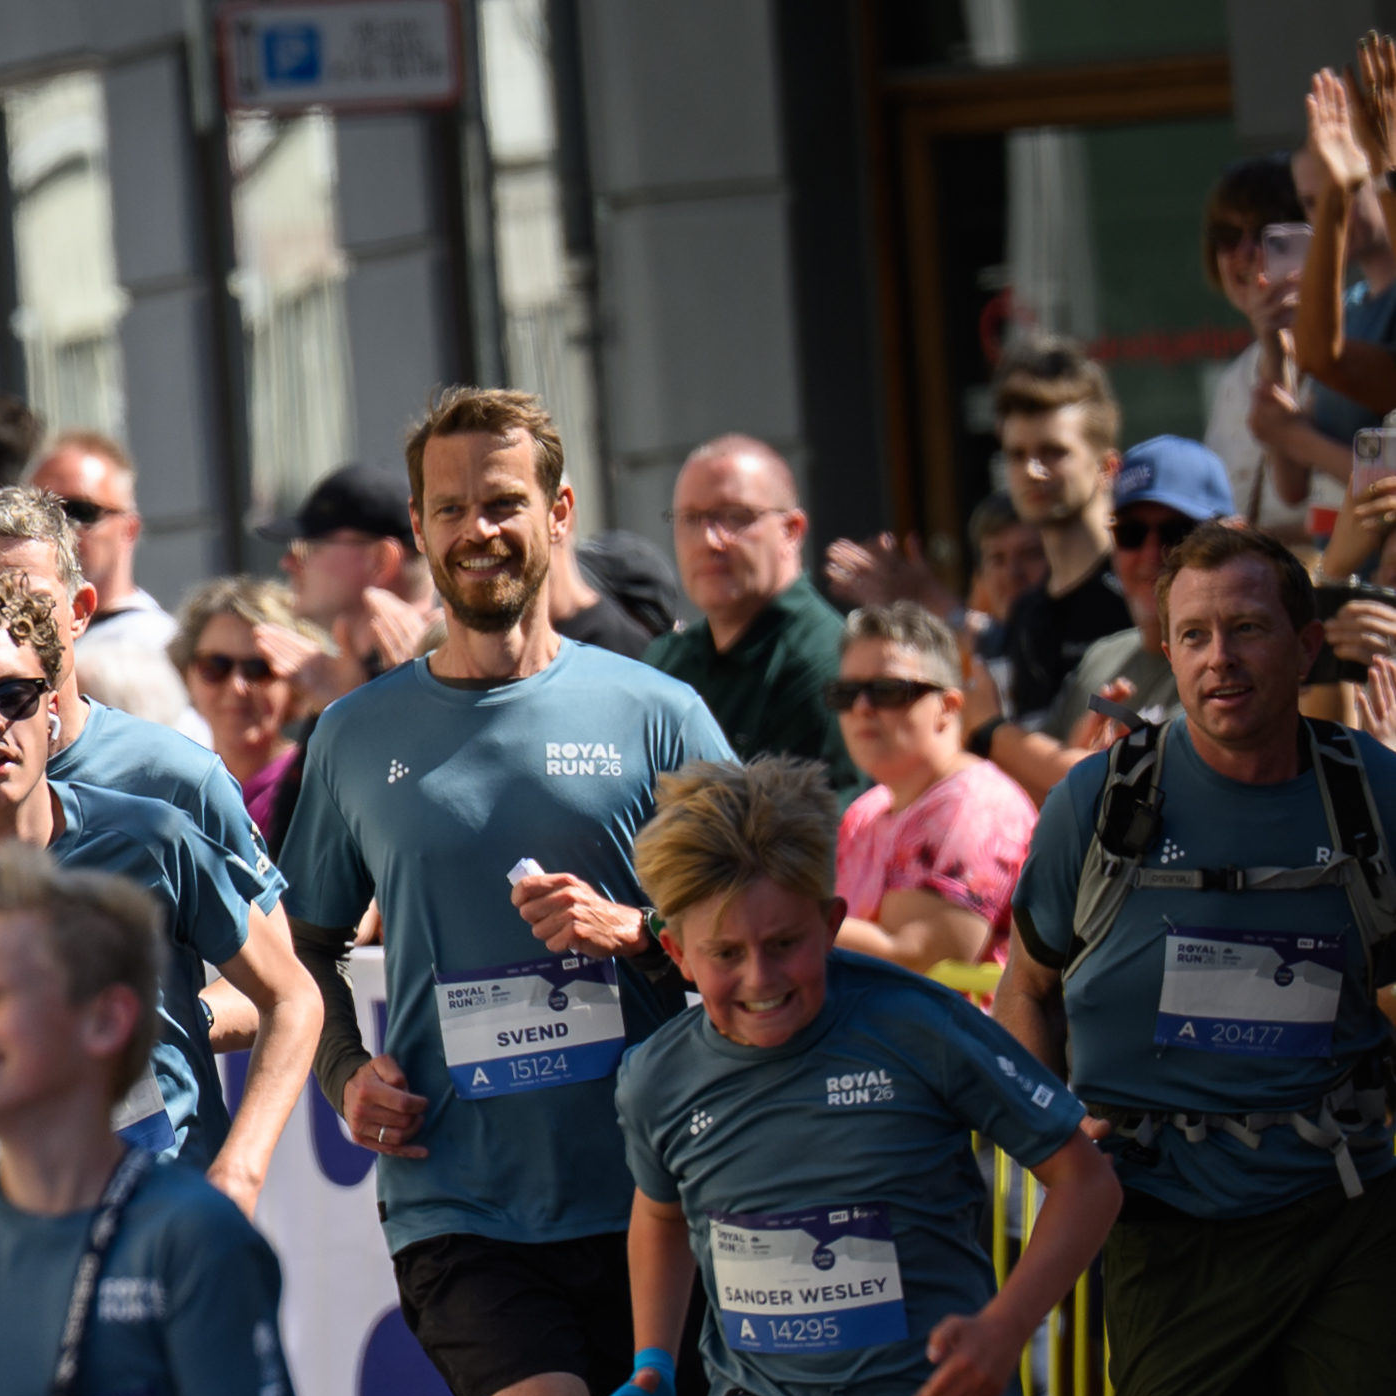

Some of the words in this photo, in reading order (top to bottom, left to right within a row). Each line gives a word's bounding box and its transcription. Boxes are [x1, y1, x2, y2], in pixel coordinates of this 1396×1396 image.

[546, 742, 621, 759] ROYAL
[1178, 943, 1216, 955] ROYAL
[447, 986, 485, 1000] ROYAL
[497, 1022, 568, 1047] SVEND
[1178, 1021, 1196, 1038] A
[1211, 1023, 1283, 1044] 20477
[471, 1067, 490, 1086] A
[509, 1054, 568, 1080] 15124
[826, 1069, 893, 1092] ROYAL
[717, 1230, 746, 1244] ROYAL
[725, 1285, 793, 1306] SANDER
[799, 1277, 887, 1304] WESLEY
[740, 1318, 756, 1339] A
[768, 1316, 840, 1341] 14295
